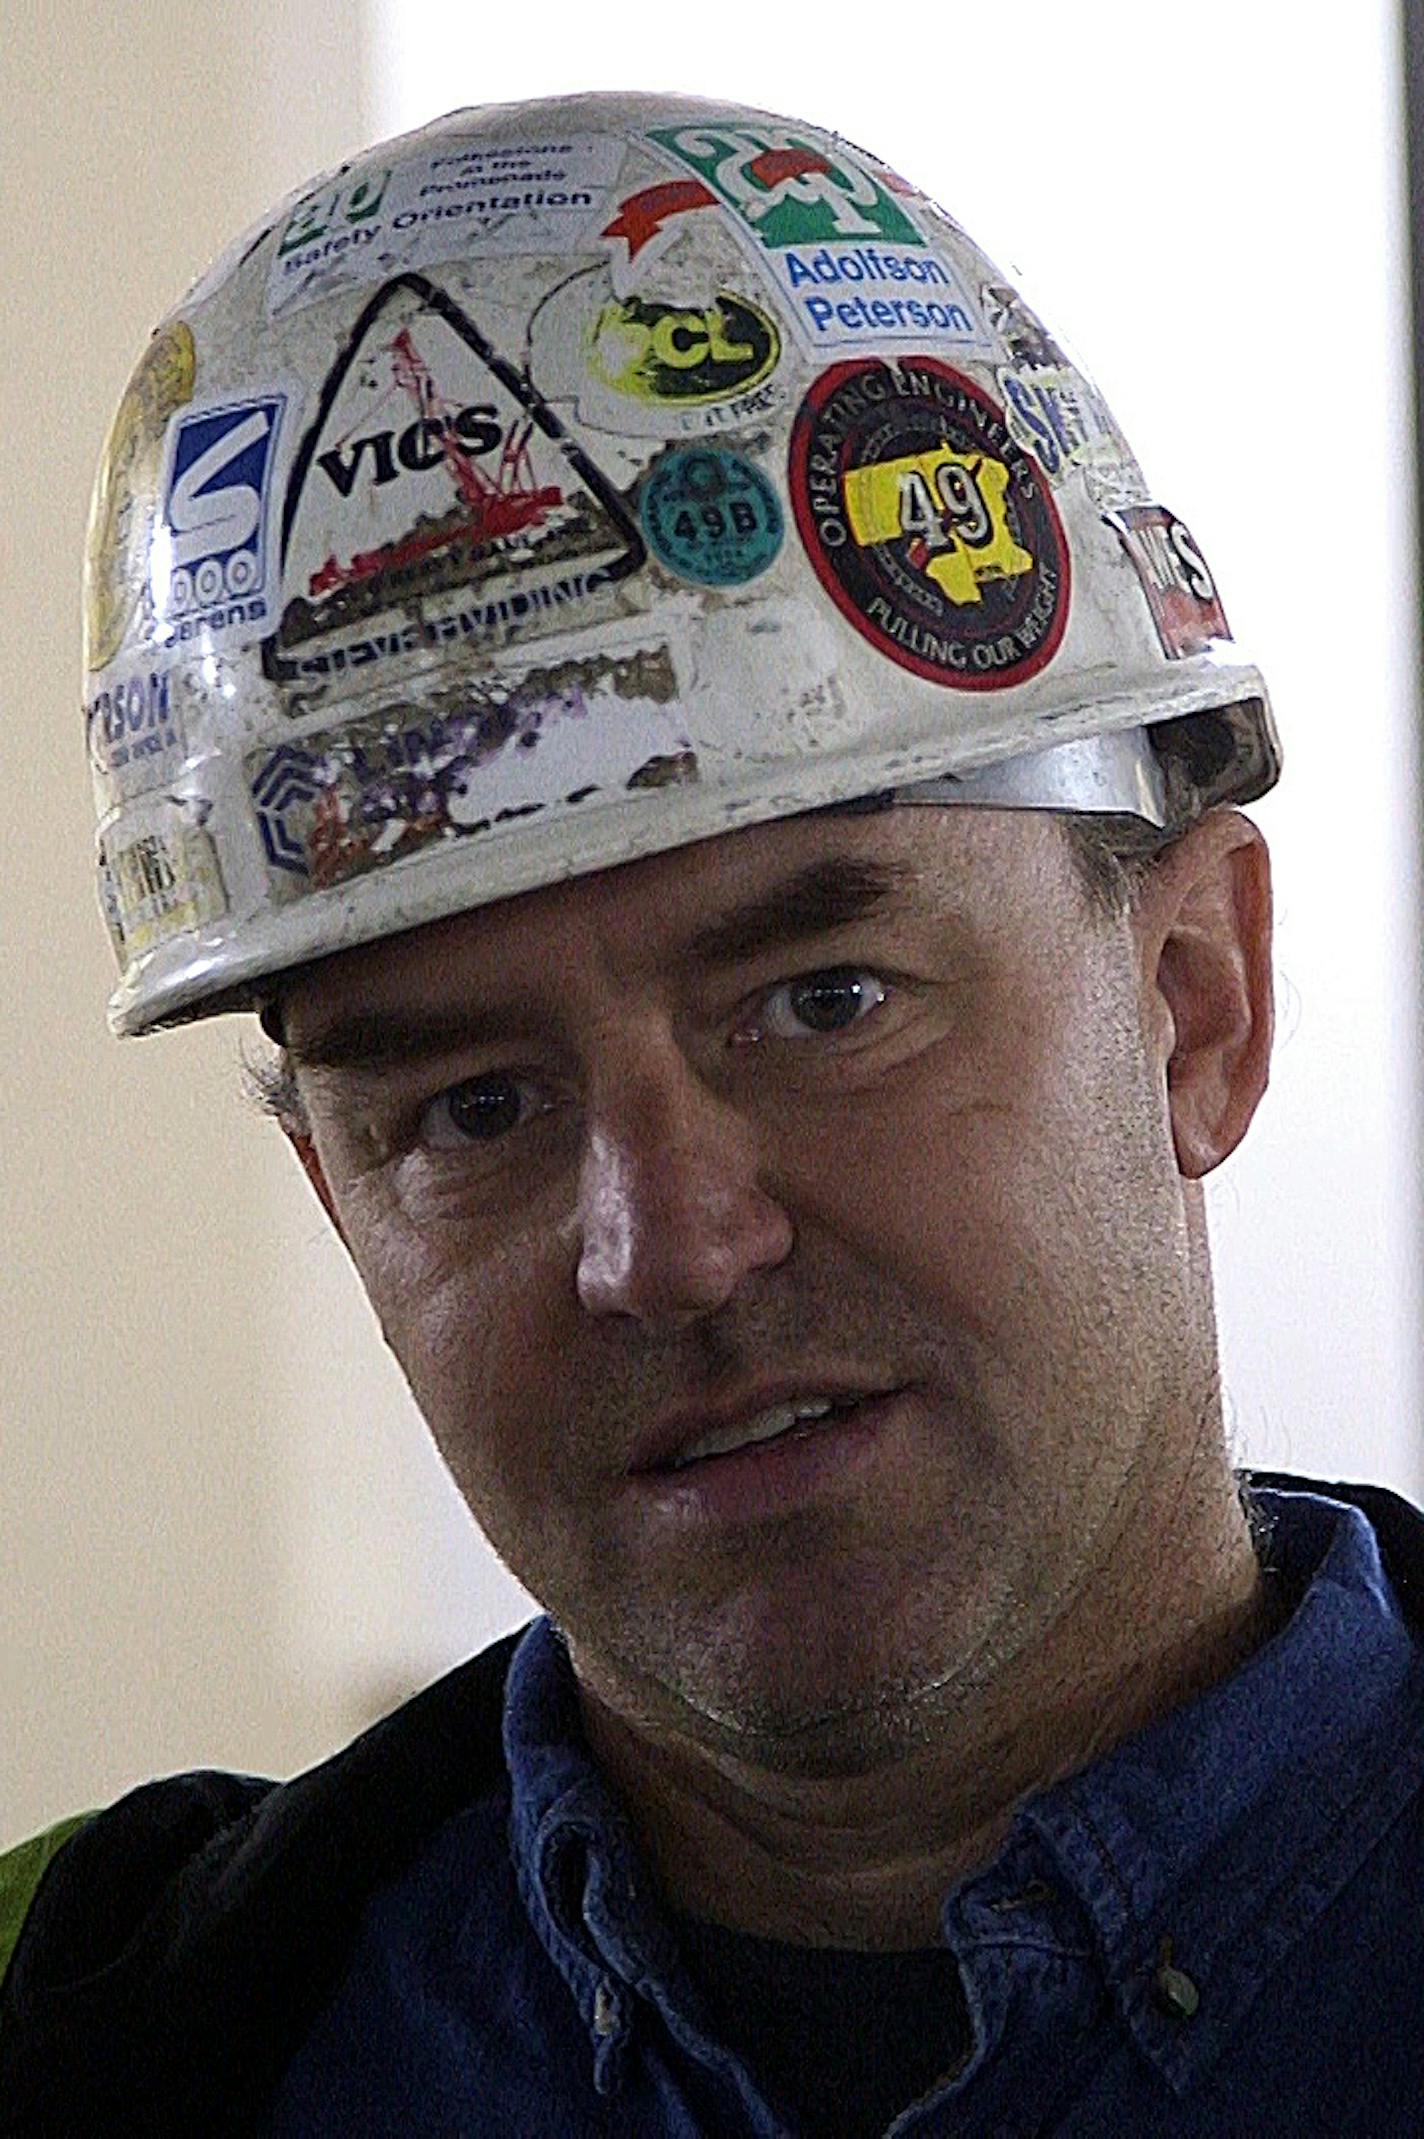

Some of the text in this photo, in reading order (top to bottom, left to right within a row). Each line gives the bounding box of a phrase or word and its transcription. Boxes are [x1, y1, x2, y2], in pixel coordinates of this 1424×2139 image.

[283, 225, 382, 276] Safety
[392, 190, 592, 230] Orientation
[784, 249, 950, 288] Adolfson
[804, 296, 974, 332] Peterson
[809, 373, 888, 547] OPERATING
[894, 371, 1037, 499] ENGINEERS
[673, 502, 758, 542] 49B
[896, 463, 993, 548] 49
[298, 623, 420, 685] STEVE
[865, 597, 966, 670] PULLING
[972, 635, 1022, 670] OUR
